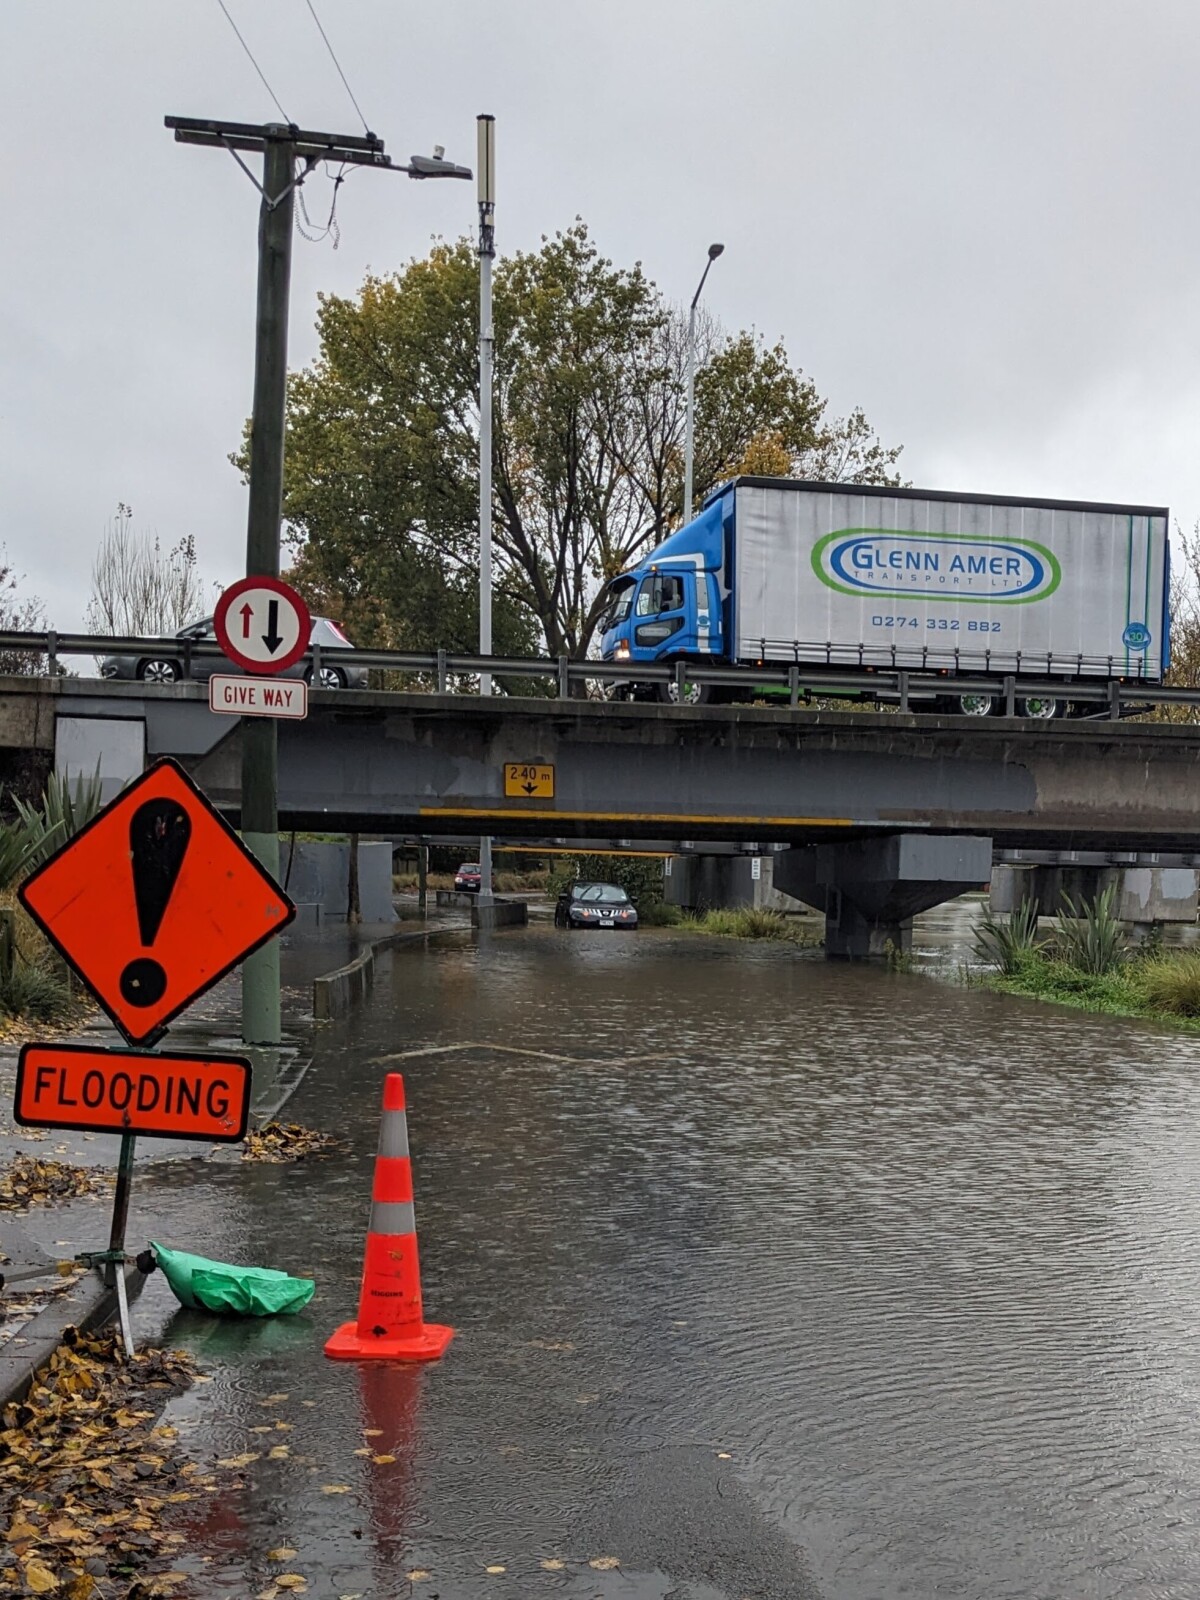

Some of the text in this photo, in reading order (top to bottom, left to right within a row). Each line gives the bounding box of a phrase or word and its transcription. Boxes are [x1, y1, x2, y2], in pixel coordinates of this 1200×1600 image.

[851, 544, 1020, 576] GLENN AMER
[854, 571, 1023, 588] TRANSPORT LTD
[872, 616, 1001, 632] 0274 332 882
[224, 685, 293, 708] GIVE WAY
[34, 1066, 230, 1118] FLOODING
